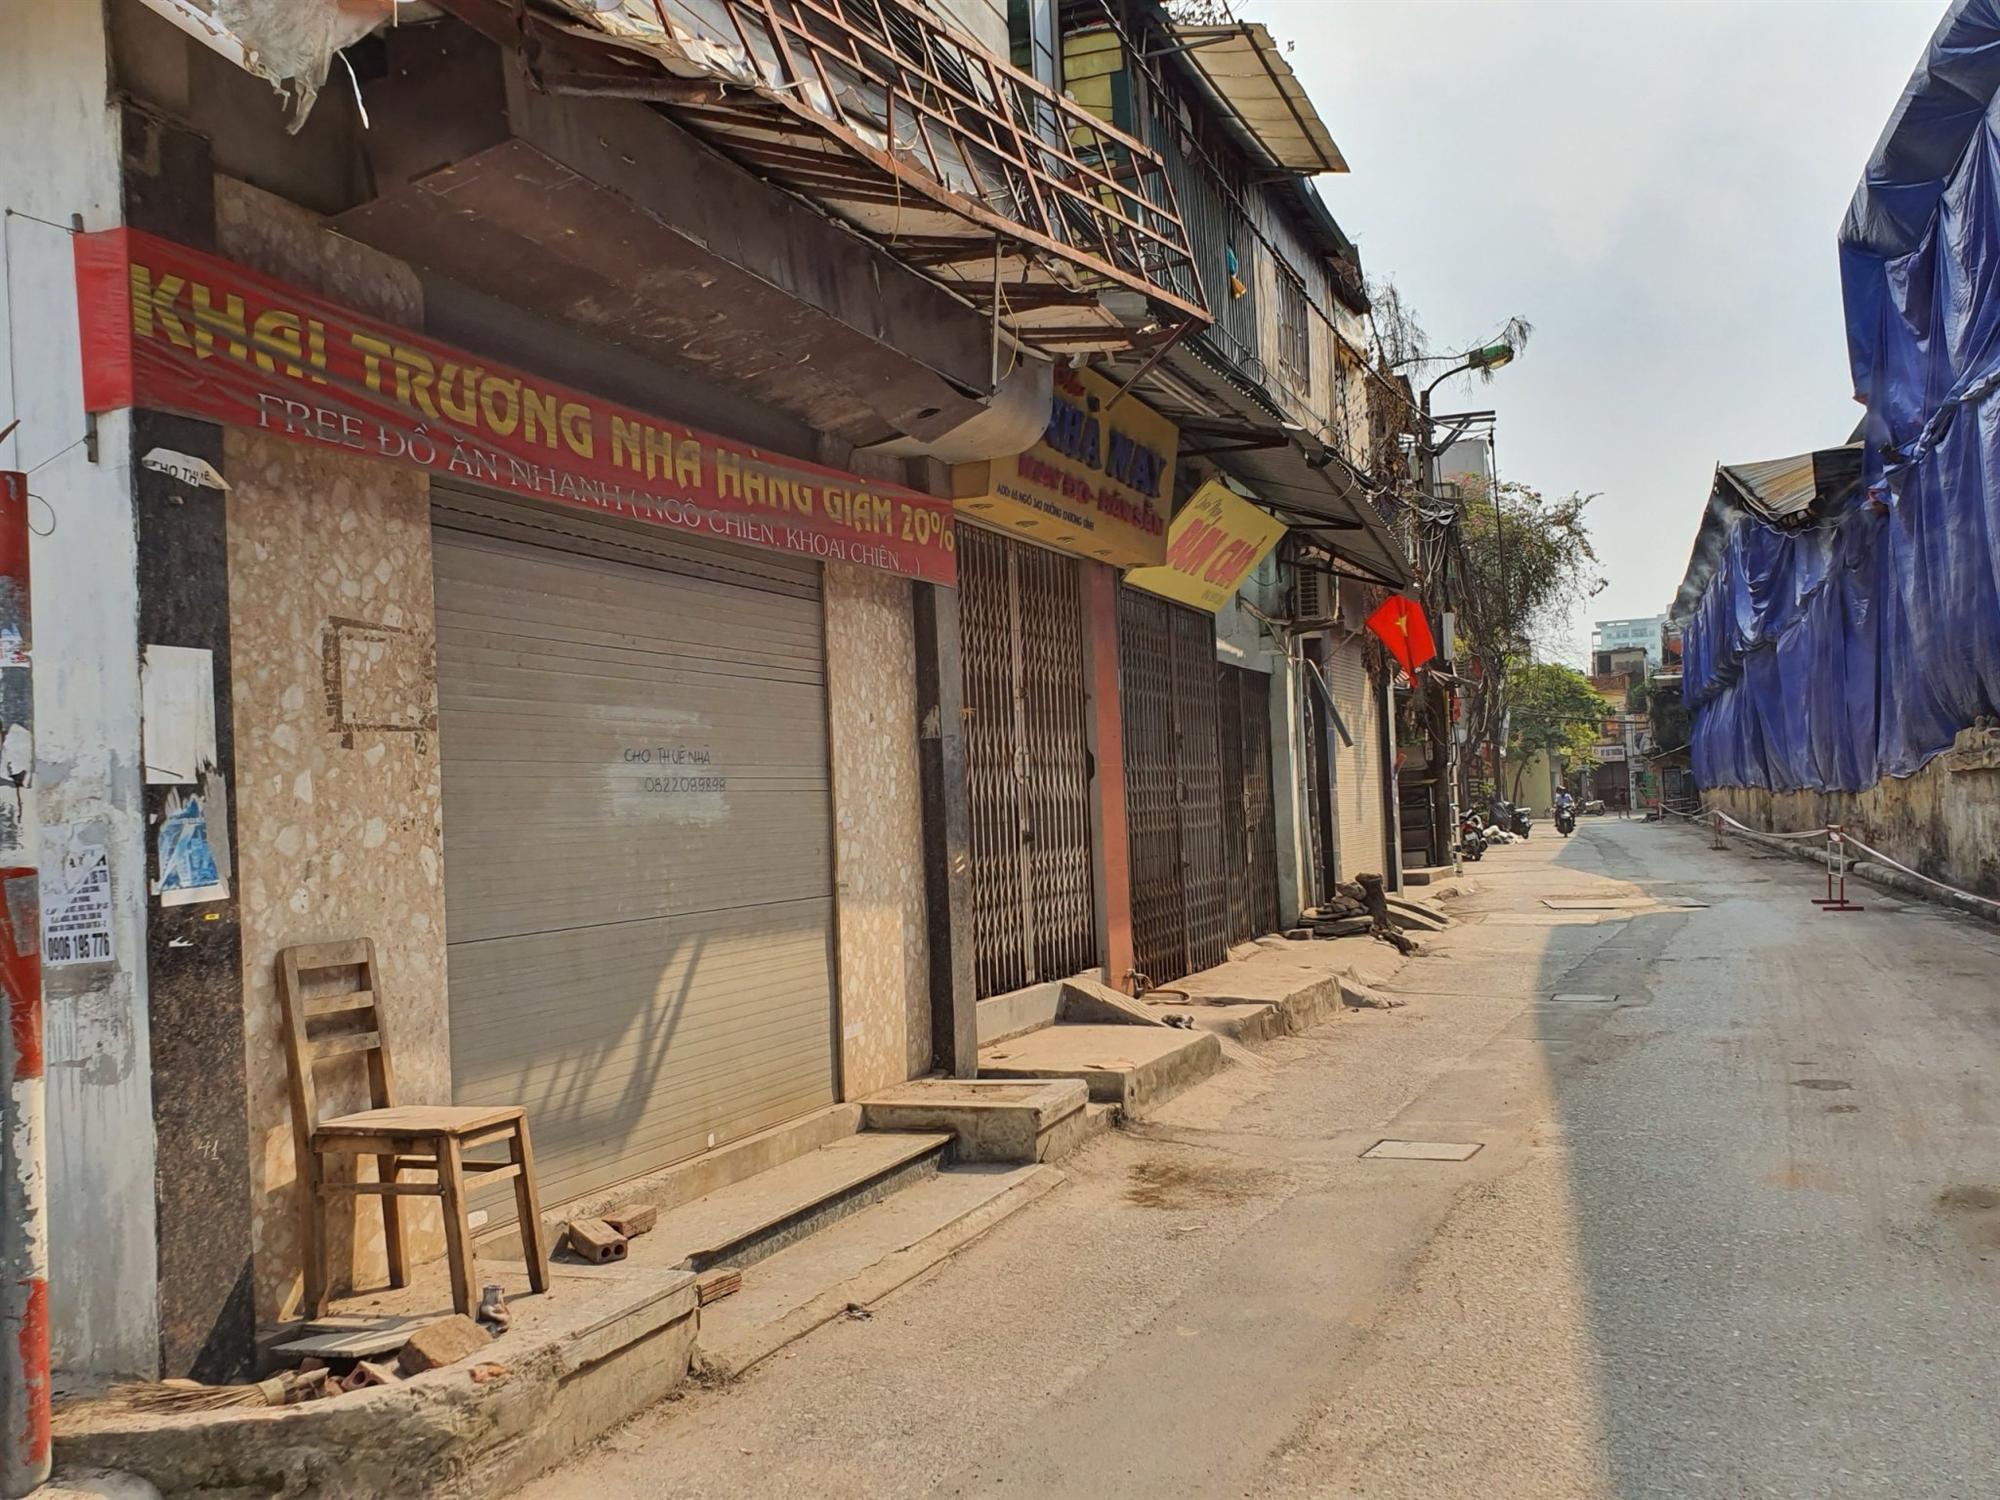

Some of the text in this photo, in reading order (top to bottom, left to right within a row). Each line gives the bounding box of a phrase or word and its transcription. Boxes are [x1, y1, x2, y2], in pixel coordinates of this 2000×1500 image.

[130, 263, 328, 385] KHAI
[351, 333, 594, 460] TRƯƠNG
[611, 415, 702, 489] NHÀ
[716, 447, 813, 517] HÀNG
[900, 504, 955, 552] 20%
[257, 392, 367, 450] FREE
[376, 423, 436, 465] ĐỒ
[448, 435, 498, 481] ĂN
[507, 457, 623, 511] NHANH
[786, 527, 846, 561] KHOAI
[623, 747, 652, 764] CHO
[91, 931, 110, 958] 776
